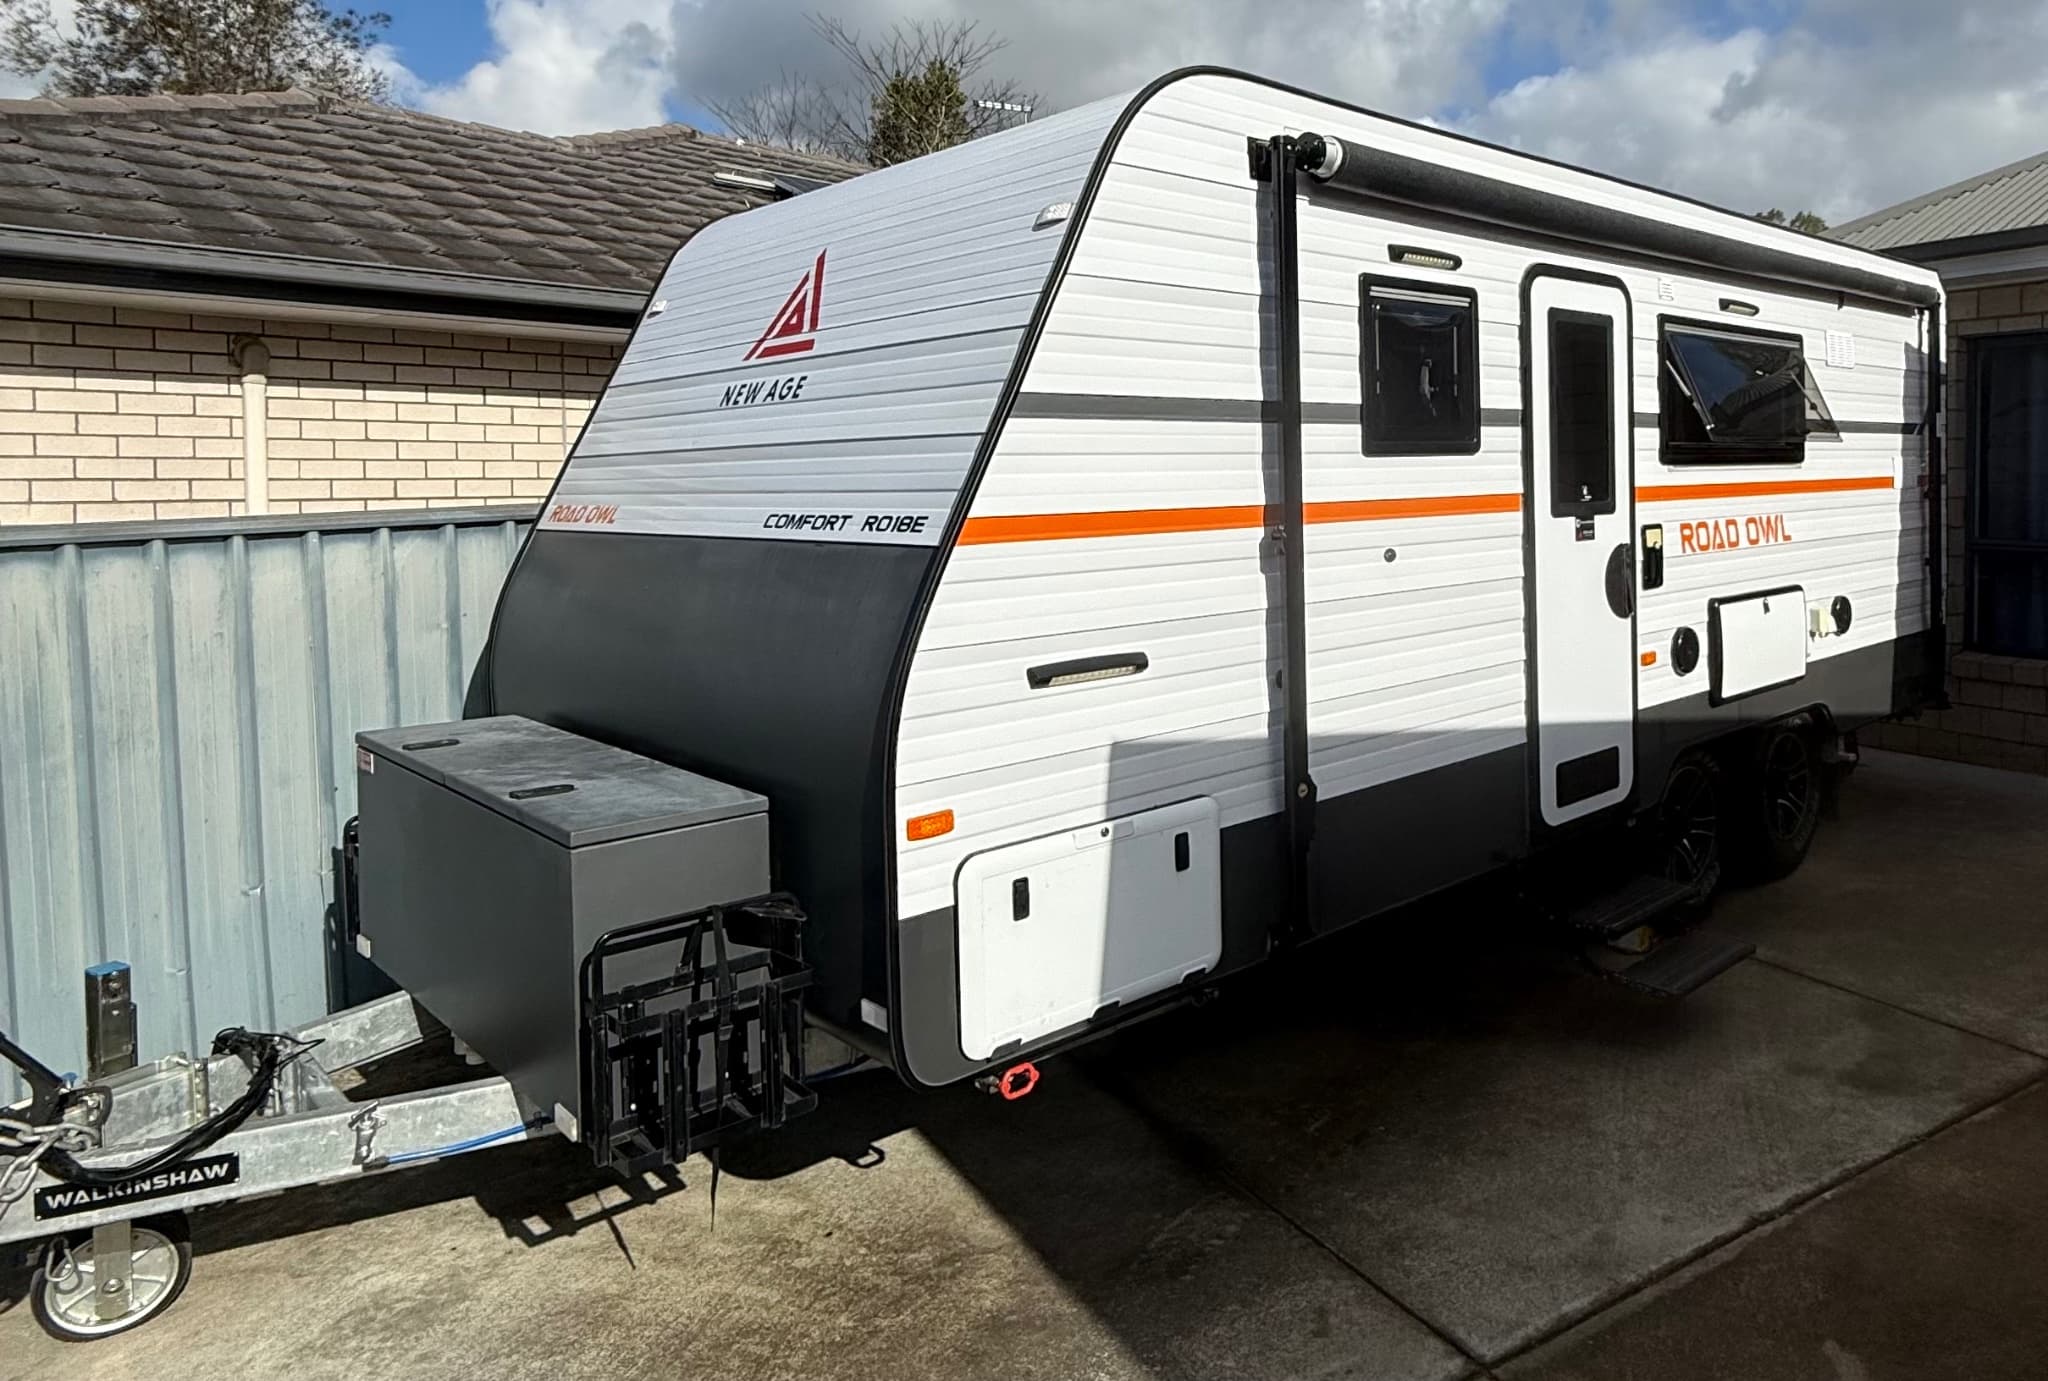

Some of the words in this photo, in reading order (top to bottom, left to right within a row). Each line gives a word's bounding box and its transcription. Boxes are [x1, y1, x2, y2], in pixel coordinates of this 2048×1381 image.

[719, 381, 766, 408] NEW
[762, 375, 809, 402] AGE
[548, 504, 588, 523] ROAD
[584, 504, 620, 524] OWL
[763, 514, 853, 532] COMFORT
[1679, 518, 1740, 554] ROAD
[1745, 514, 1792, 545] OWL
[45, 1162, 230, 1210] WALKINSHAW
